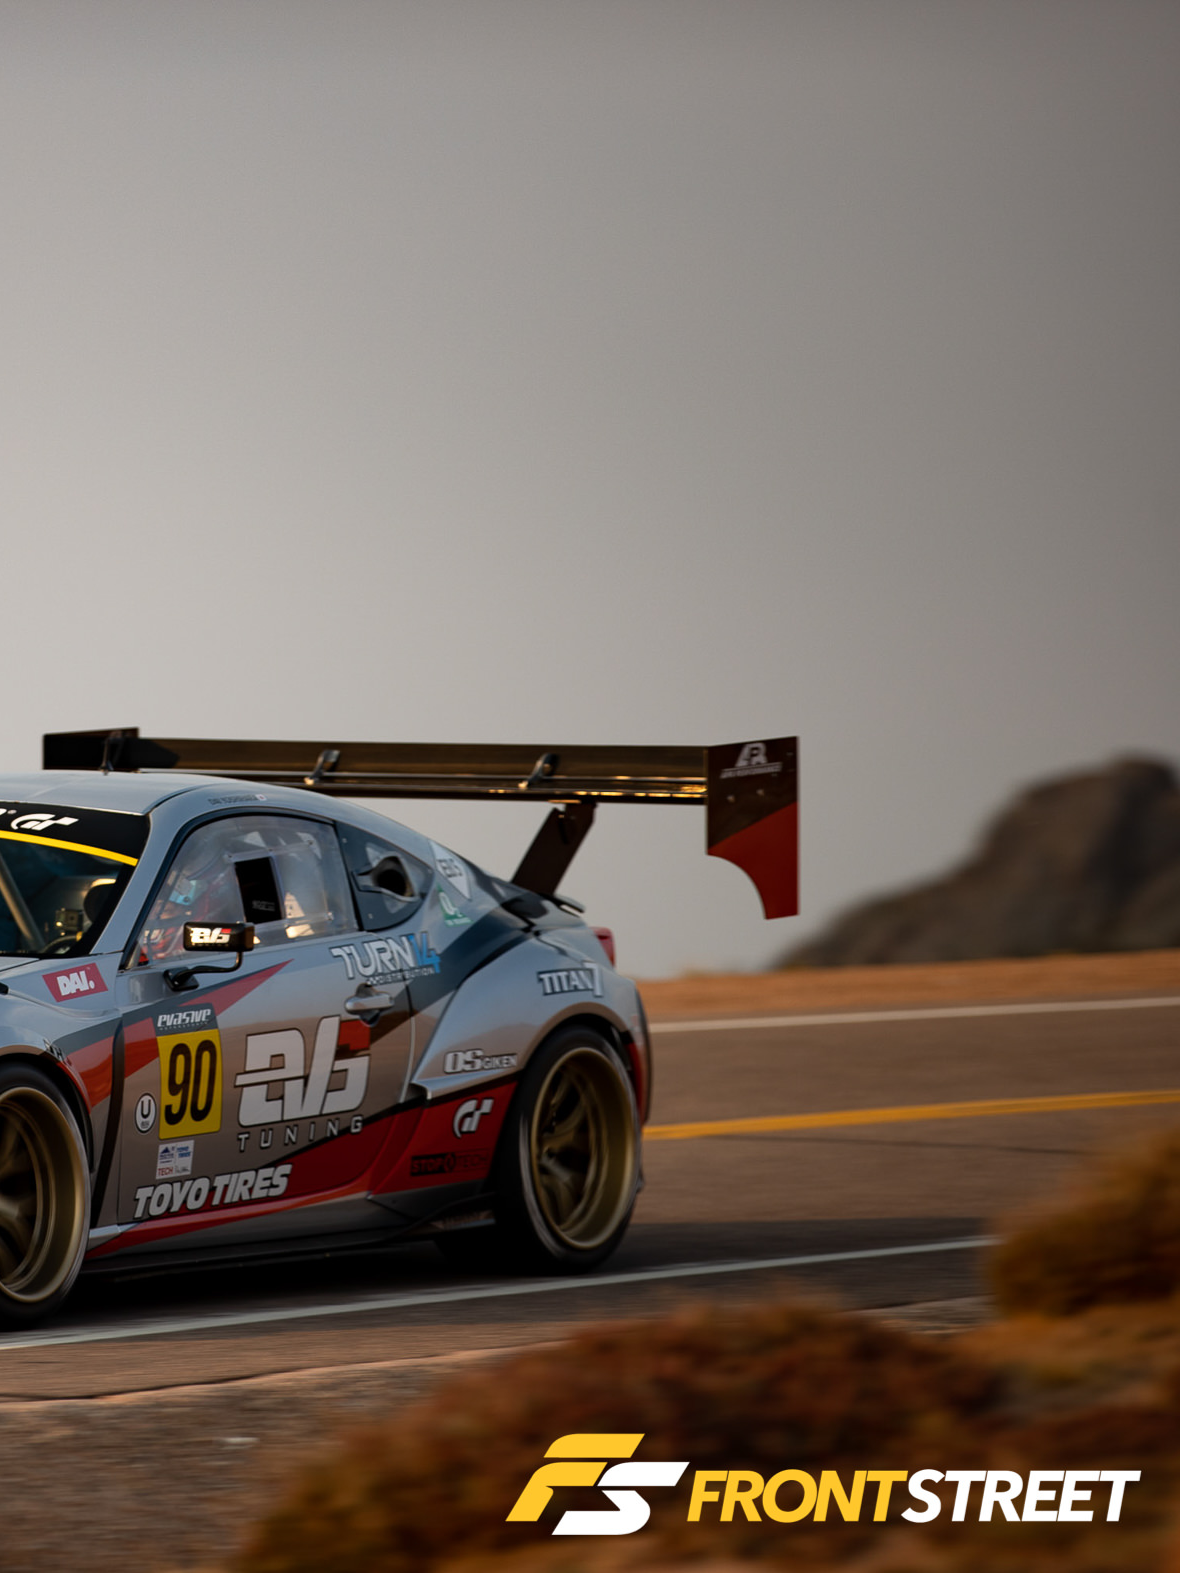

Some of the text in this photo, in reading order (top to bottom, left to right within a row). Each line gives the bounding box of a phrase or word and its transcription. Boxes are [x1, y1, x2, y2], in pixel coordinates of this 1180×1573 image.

[444, 1049, 518, 1074] OS GIKEN
[164, 1039, 217, 1126] 90
[140, 1099, 152, 1119] U
[237, 1114, 364, 1152] TUNING
[133, 1163, 293, 1219] TOYO TIRES
